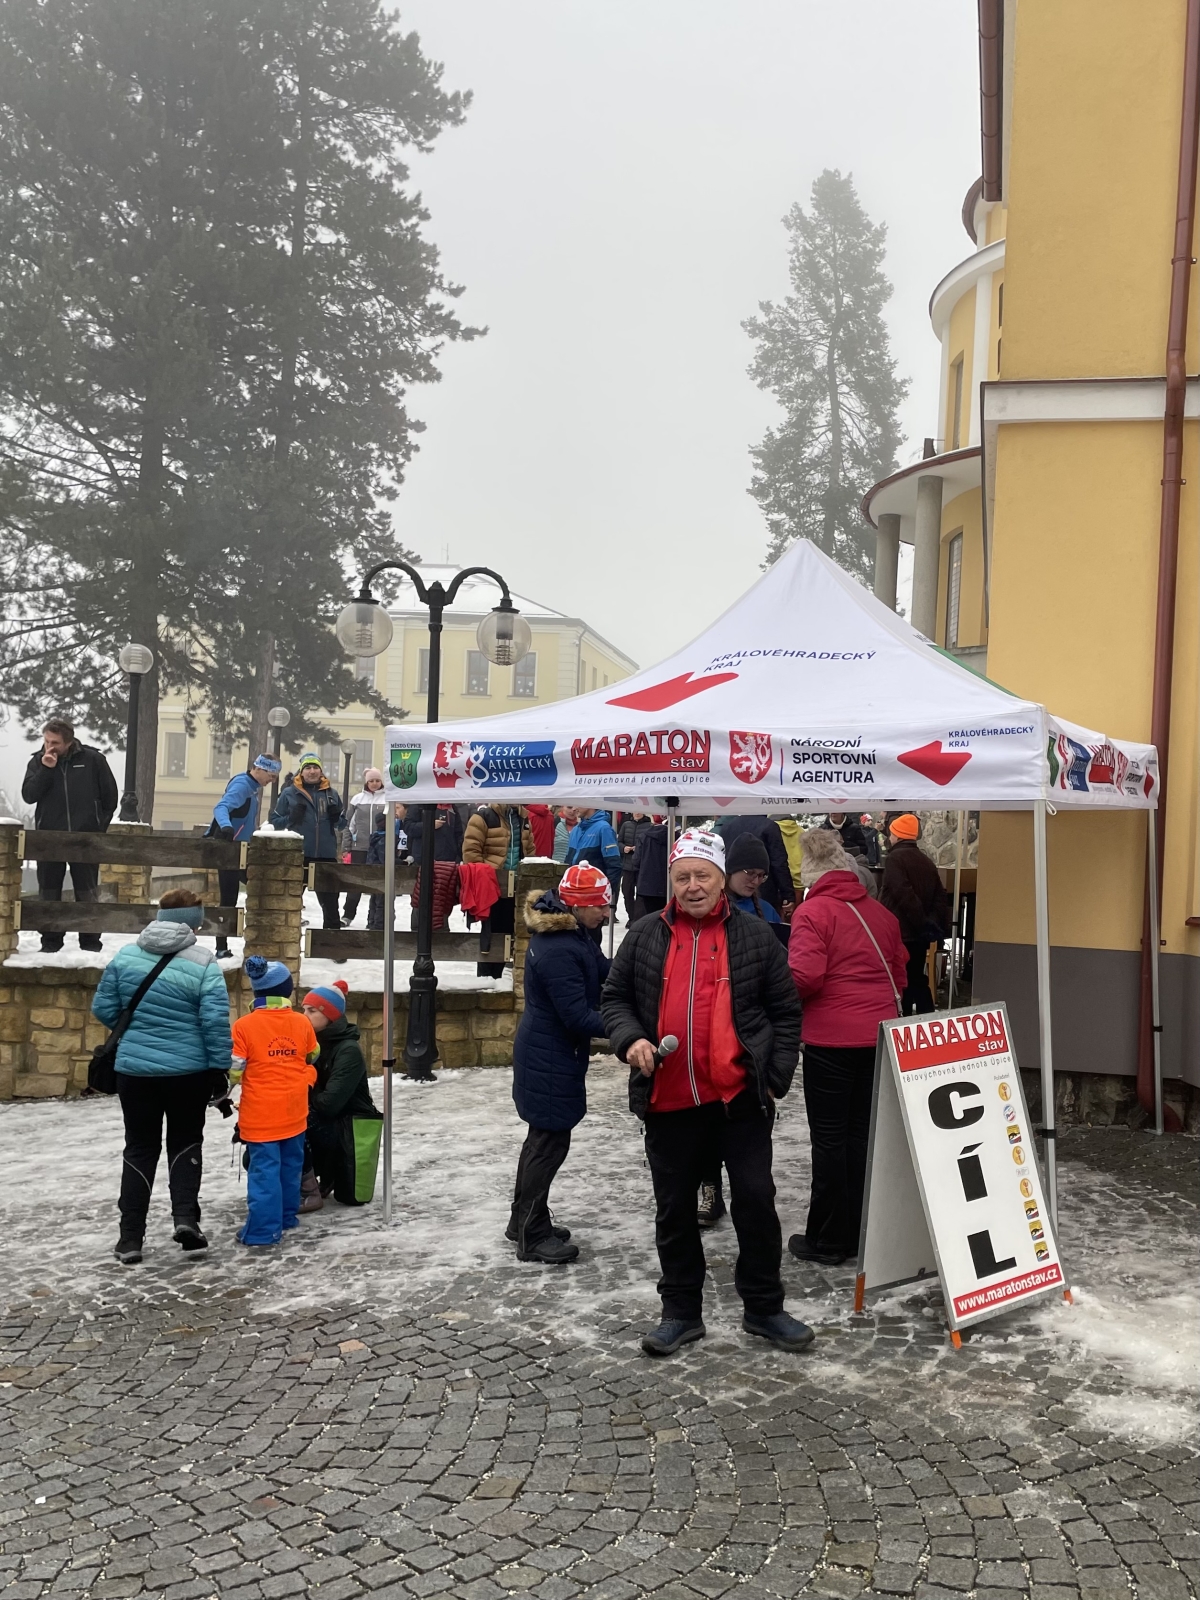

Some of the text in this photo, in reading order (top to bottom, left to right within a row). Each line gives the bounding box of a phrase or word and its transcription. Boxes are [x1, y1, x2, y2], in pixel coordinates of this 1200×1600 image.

[711, 649, 876, 664] KRÁLOVÉHRADECKÝ
[703, 659, 742, 673] KRAJ
[948, 725, 1035, 738] KRÁLOVÉHRADECKÝ
[570, 729, 711, 759] MARATON
[790, 735, 863, 748] NÁRODNÍ
[948, 740, 970, 748] KRAJ
[488, 744, 526, 756] ČESKÝ
[792, 749, 877, 765] SPORTOVNÍ
[488, 755, 551, 770] ATLETICKÝ
[670, 757, 705, 768] stav
[492, 771, 522, 783] SVAZ
[640, 774, 677, 785] jednota
[682, 773, 710, 784] Úpice
[791, 770, 875, 784] AGENTURA
[891, 1010, 1005, 1053] MARATON
[978, 1039, 1004, 1052] stav
[959, 1061, 988, 1073] jednota
[990, 1055, 1011, 1067] Úpice
[928, 1081, 1017, 1280] CÍL
[957, 1266, 1058, 1312] www.maratonstav.cz
